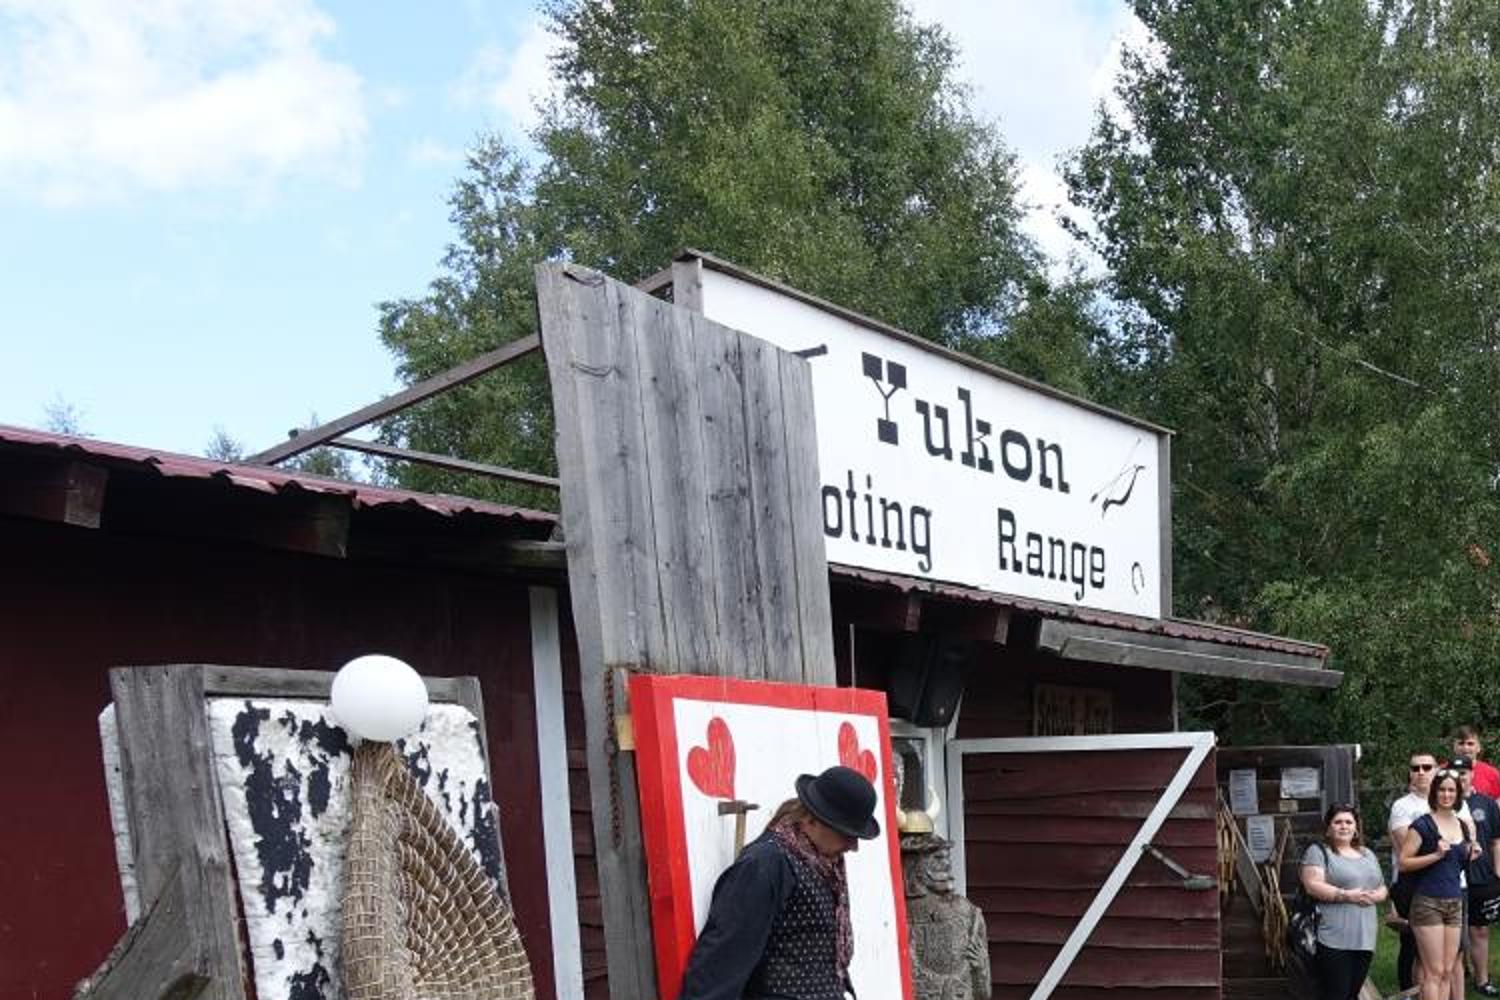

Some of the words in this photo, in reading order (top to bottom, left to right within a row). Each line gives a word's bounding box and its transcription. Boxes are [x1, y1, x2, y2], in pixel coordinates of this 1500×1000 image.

[861, 351, 1071, 494] Yukon
[821, 469, 932, 573] oting
[997, 507, 1105, 601] Range
